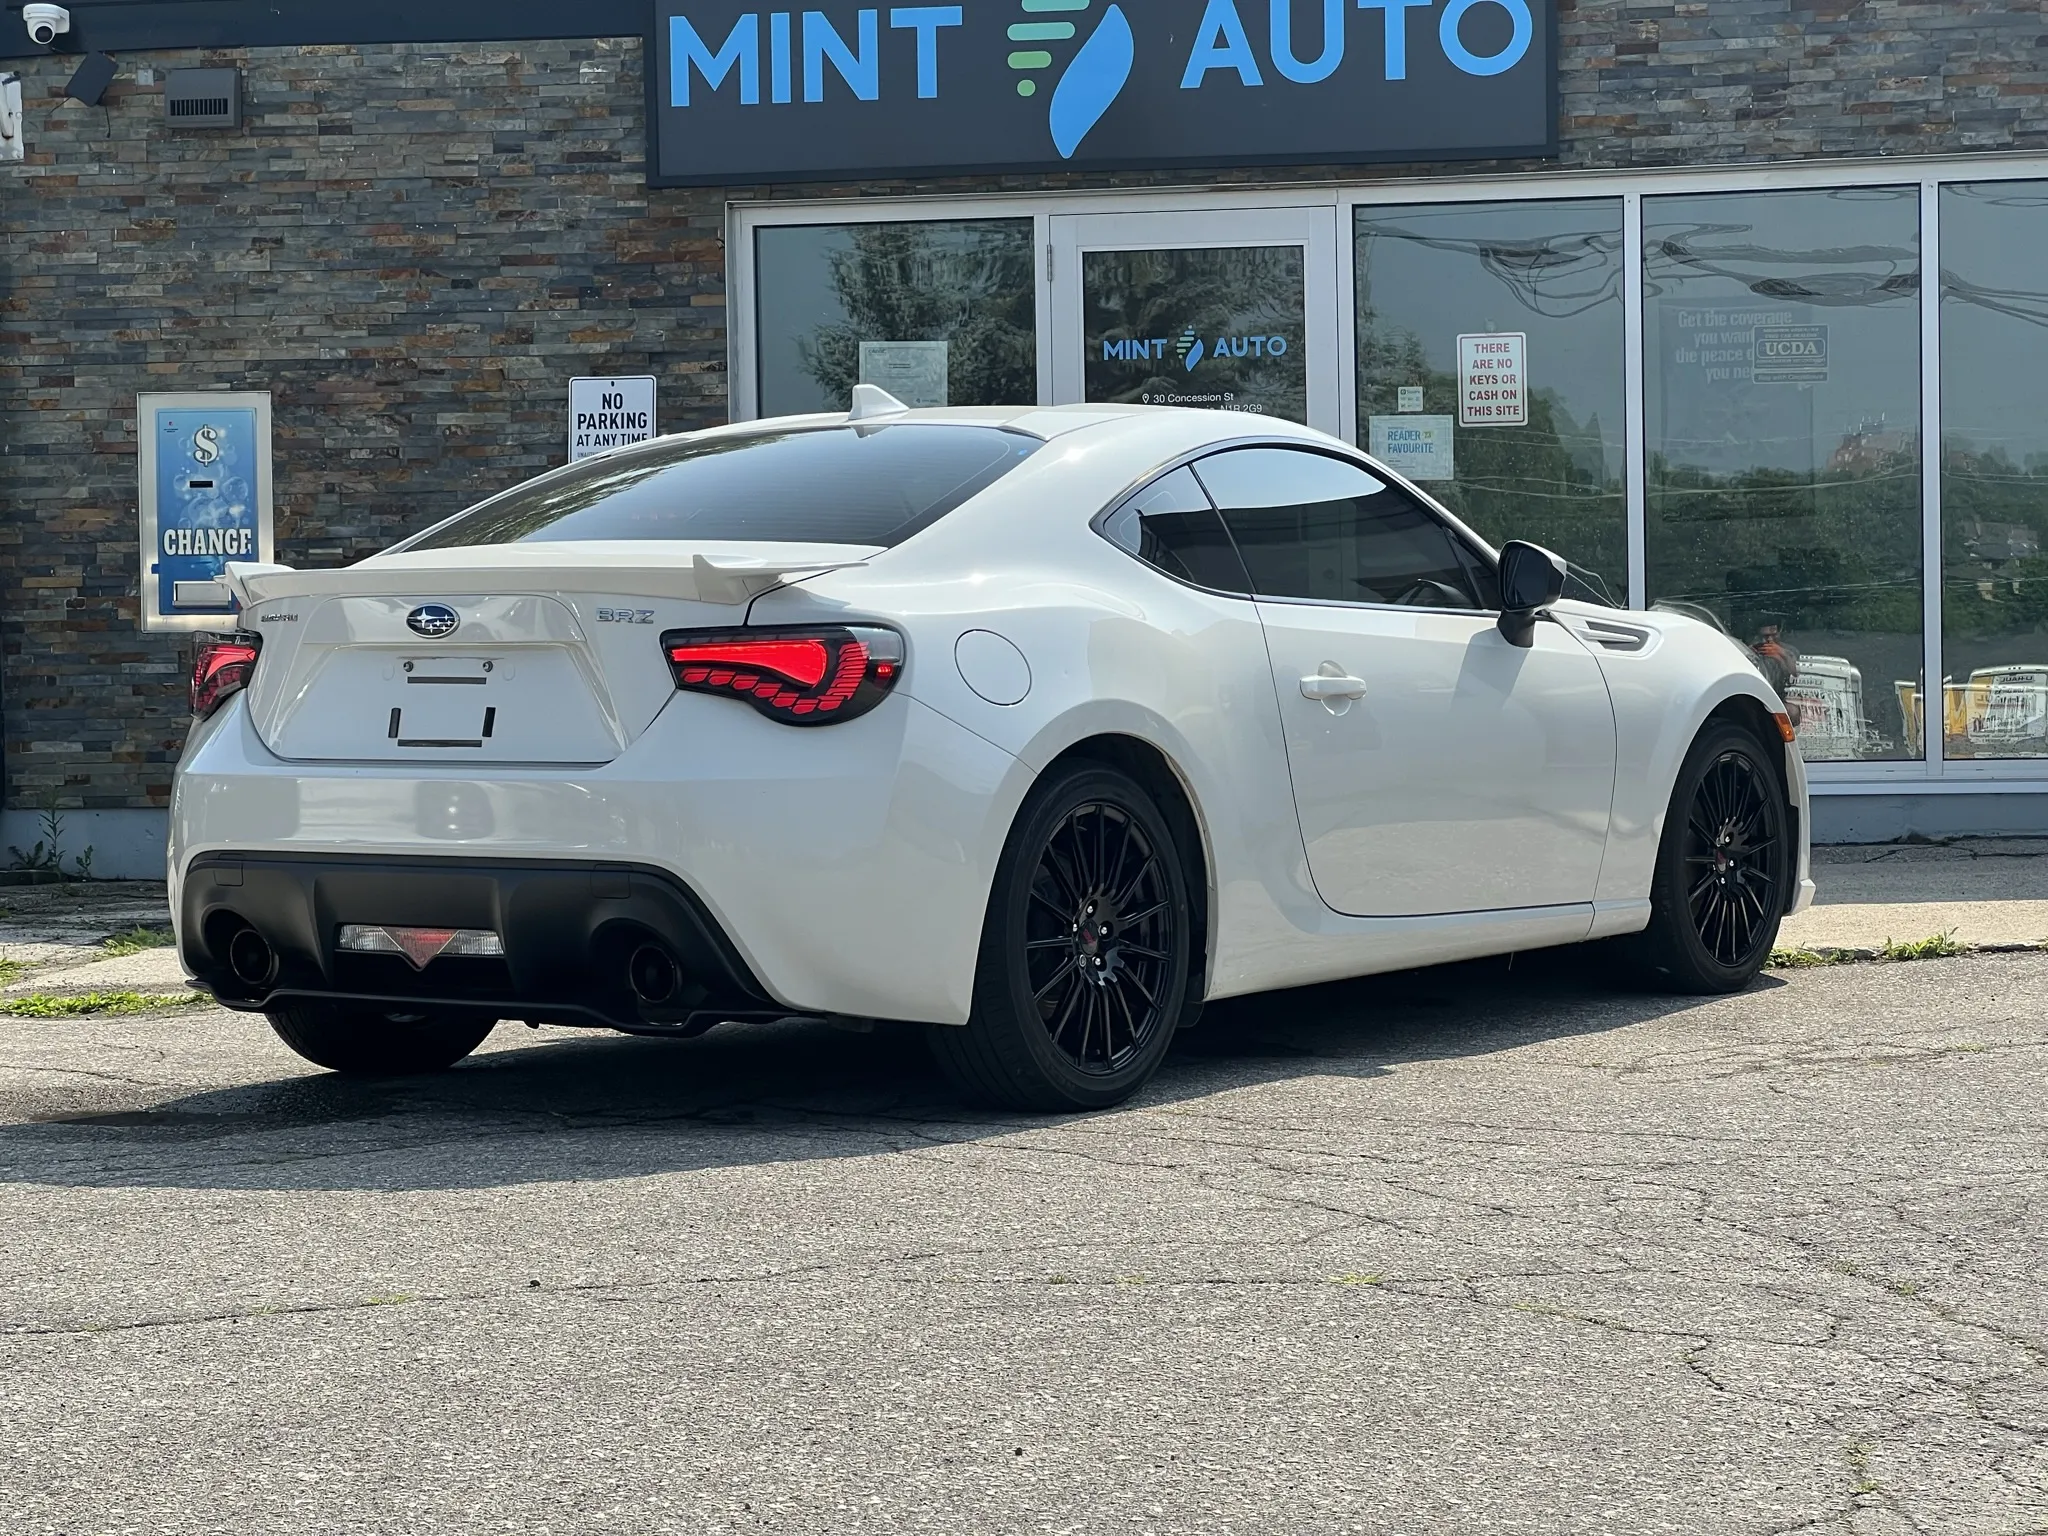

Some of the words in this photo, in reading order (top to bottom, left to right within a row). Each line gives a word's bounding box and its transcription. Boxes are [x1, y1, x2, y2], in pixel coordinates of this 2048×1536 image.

[669, 5, 963, 107] MINT
[1179, 0, 1533, 89] AUTO
[1678, 311, 1701, 327] Get
[1704, 310, 1726, 326] the
[1694, 332, 1718, 348] you
[1720, 331, 1753, 344] wan
[1103, 339, 1168, 361] MINT
[1213, 336, 1288, 358] AUTO
[1474, 343, 1510, 354] THERE
[1765, 342, 1817, 355] UCDA
[1472, 359, 1493, 369] ARE
[1497, 359, 1513, 368] NO
[1676, 349, 1698, 363] the
[1702, 349, 1743, 366] peace
[1469, 375, 1498, 385] KEYS
[1502, 374, 1516, 384] OR
[1706, 367, 1730, 384] you
[602, 393, 623, 410] NO
[1153, 394, 1165, 403] 30
[1168, 393, 1221, 403] Concession
[1223, 392, 1234, 402] St
[1469, 390, 1498, 400] CASH
[1502, 390, 1517, 400] ON
[1242, 403, 1263, 413] 2G9
[1467, 406, 1492, 416] THIS
[1496, 405, 1520, 415] SITE
[577, 412, 647, 430] PARKING
[576, 434, 591, 447] AT
[594, 433, 617, 446] ANY
[1388, 430, 1421, 441] READER
[1388, 443, 1434, 453] FAVOURITE
[163, 528, 252, 555] CHANGE
[596, 608, 655, 624] BRZ
